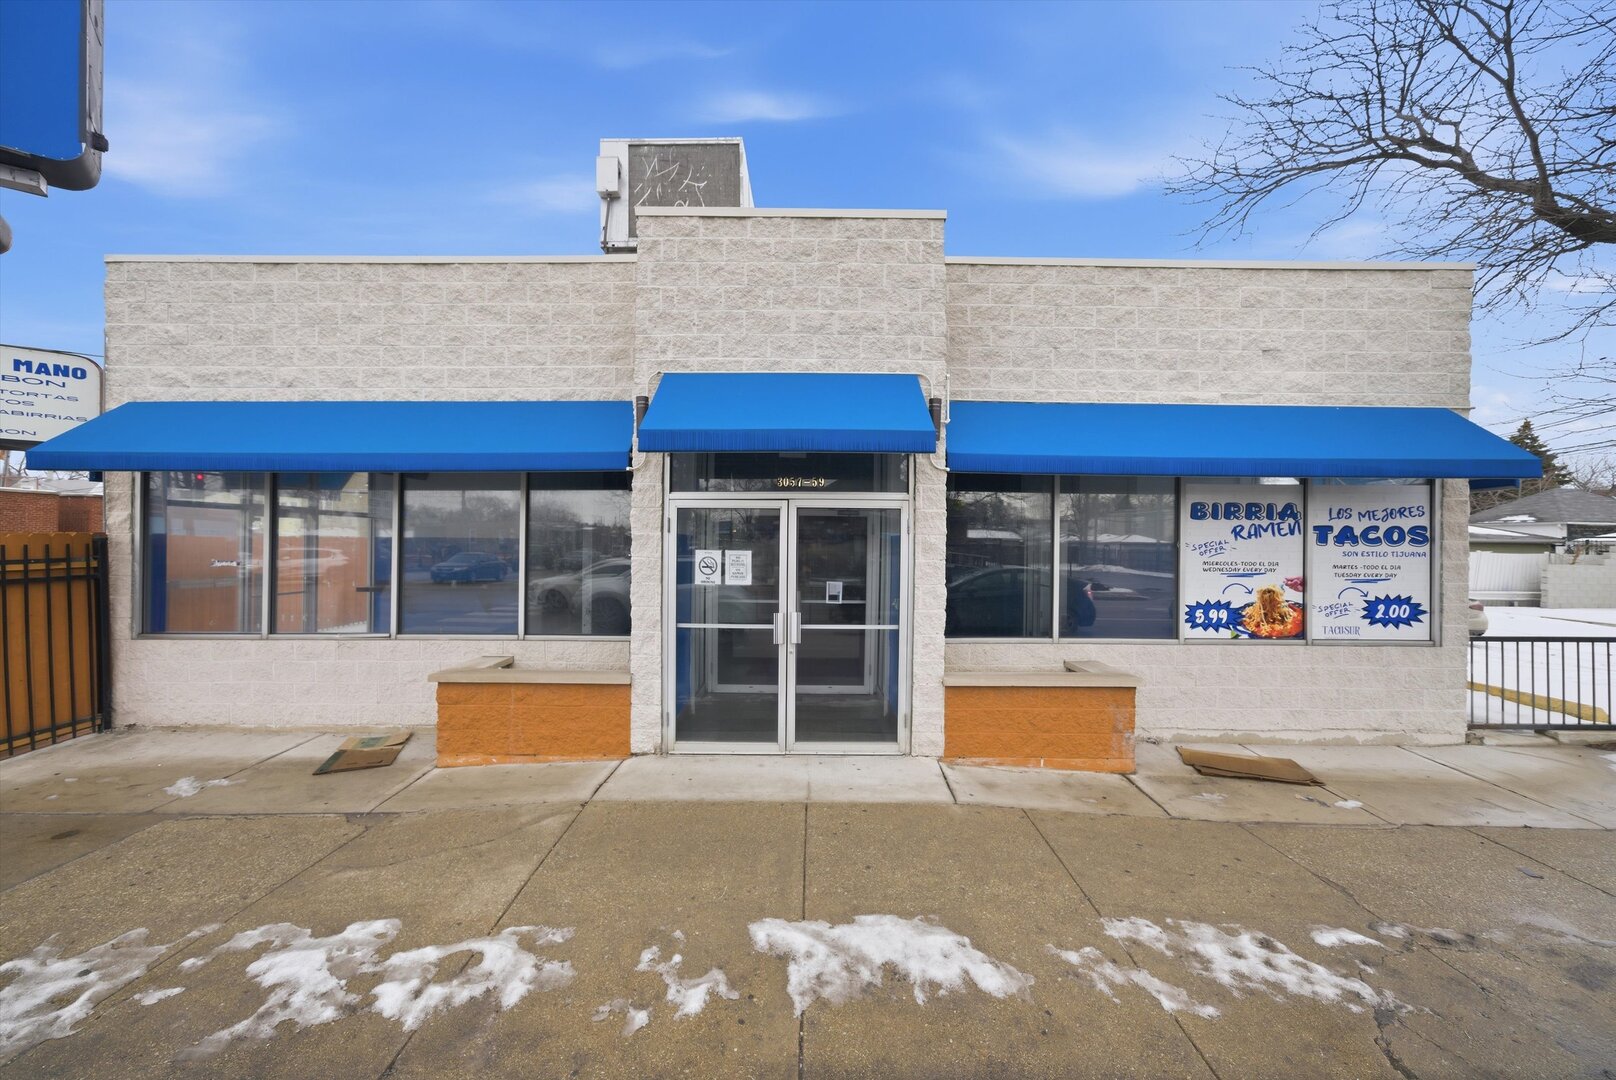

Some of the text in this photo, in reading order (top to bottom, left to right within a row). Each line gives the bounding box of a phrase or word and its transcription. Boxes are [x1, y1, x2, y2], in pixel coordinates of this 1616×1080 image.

[13, 359, 87, 380] MANO
[0, 388, 79, 402] TORTAS
[1190, 502, 1302, 521] BIRRIA
[1328, 505, 1425, 522] LOS MEJORES
[1231, 521, 1302, 541] RAMEN
[1312, 525, 1430, 548] TACOS
[1191, 540, 1230, 551] SPECIAL
[1199, 546, 1227, 556] OFFER
[1342, 550, 1427, 558] SON ESTILO TIJUANA
[1317, 601, 1354, 613] SPECIAL
[1324, 608, 1351, 617] OFFER
[1375, 604, 1410, 619] 2.00
[1195, 608, 1228, 624] 5.99
